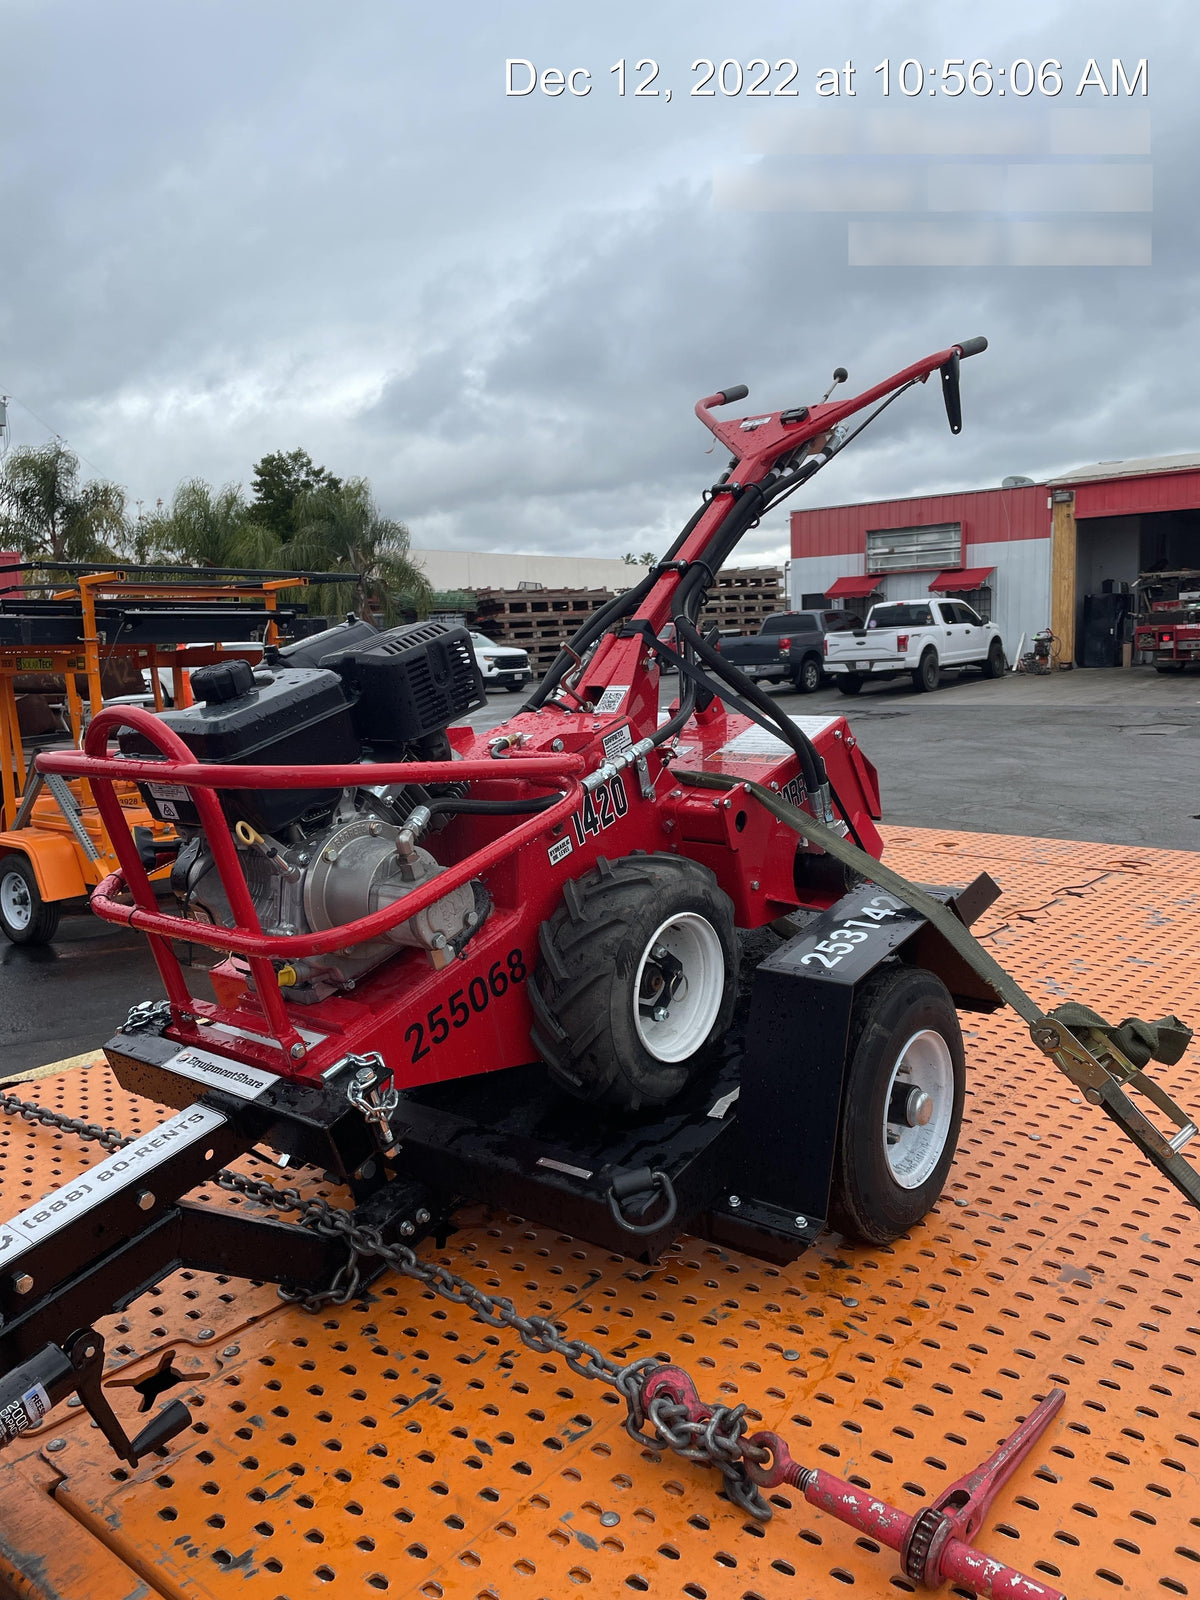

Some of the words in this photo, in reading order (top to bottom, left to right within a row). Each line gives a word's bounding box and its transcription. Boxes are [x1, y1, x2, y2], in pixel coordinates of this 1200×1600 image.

[571, 774, 628, 847] 1420
[800, 896, 906, 969] 253142
[404, 948, 527, 1064] 255068
[187, 1056, 264, 1089] EquipmentShare
[96, 1112, 205, 1182] 80-RENTS
